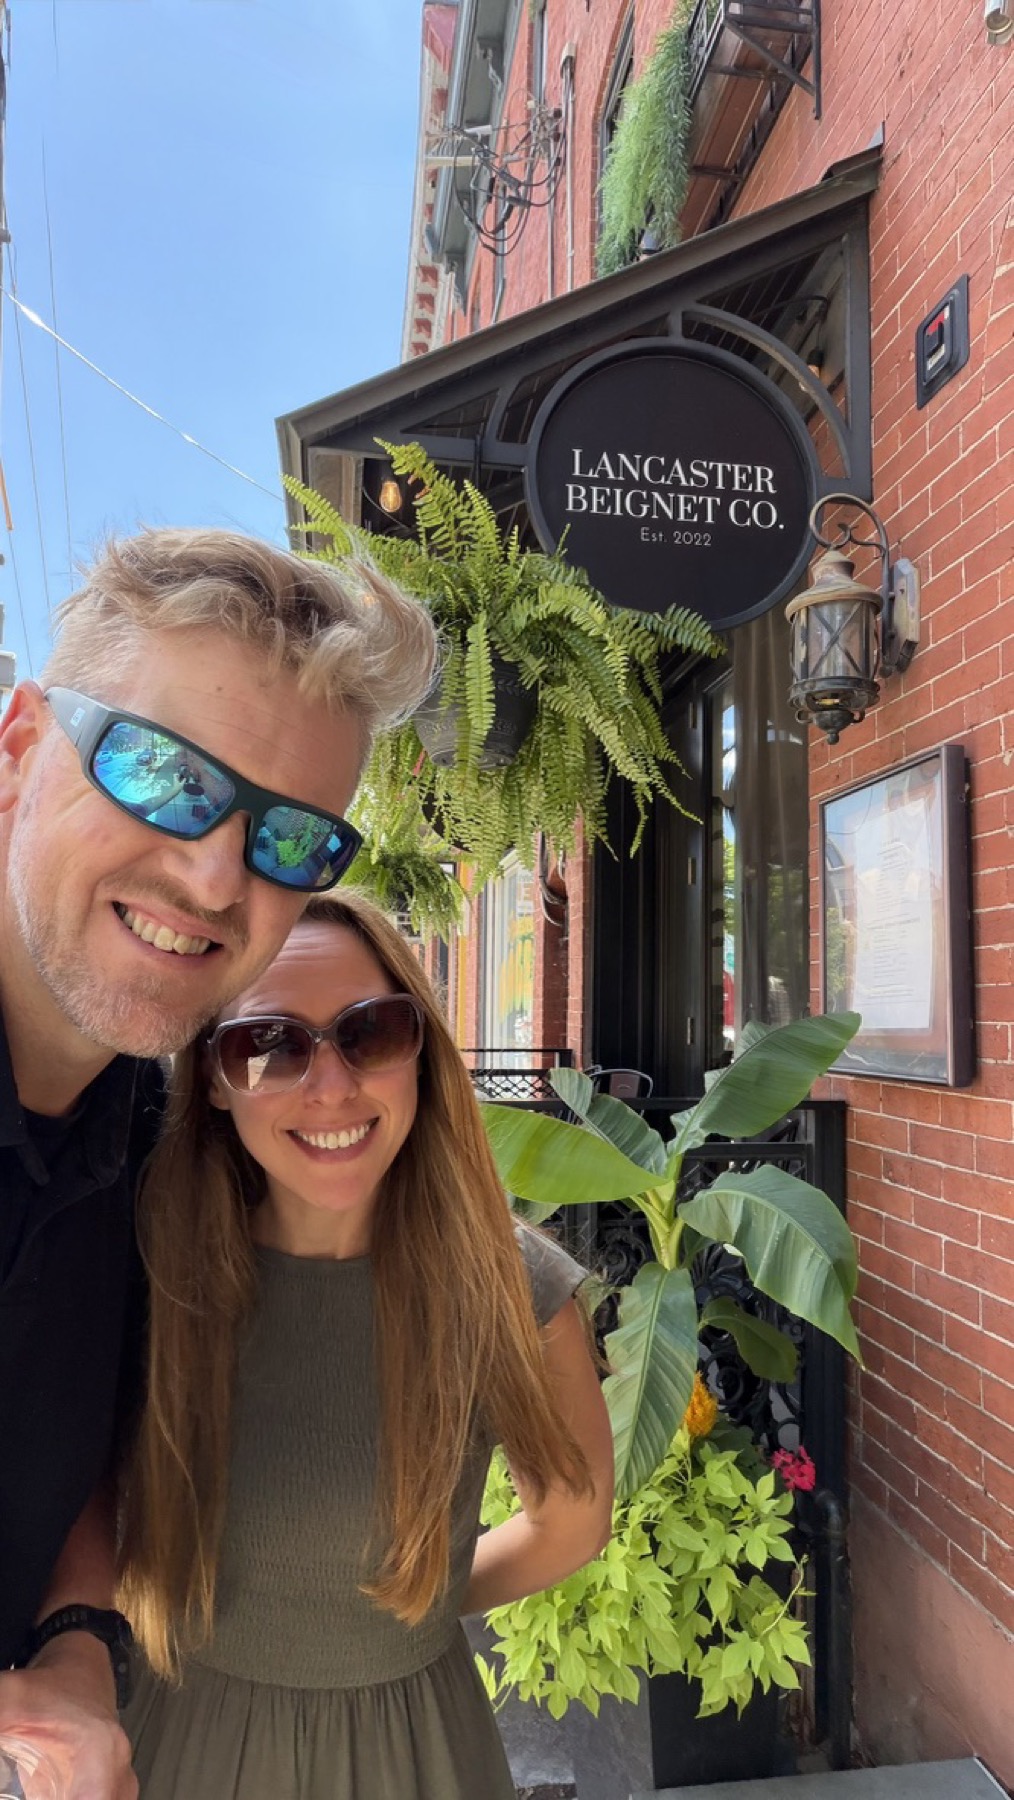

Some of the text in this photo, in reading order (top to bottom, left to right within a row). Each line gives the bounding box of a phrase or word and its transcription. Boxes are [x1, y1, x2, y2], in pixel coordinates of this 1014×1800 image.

[572, 448, 777, 494] LANCASTER
[565, 483, 785, 530] BEIGNET CO.
[640, 526, 712, 546] Est. 2022
